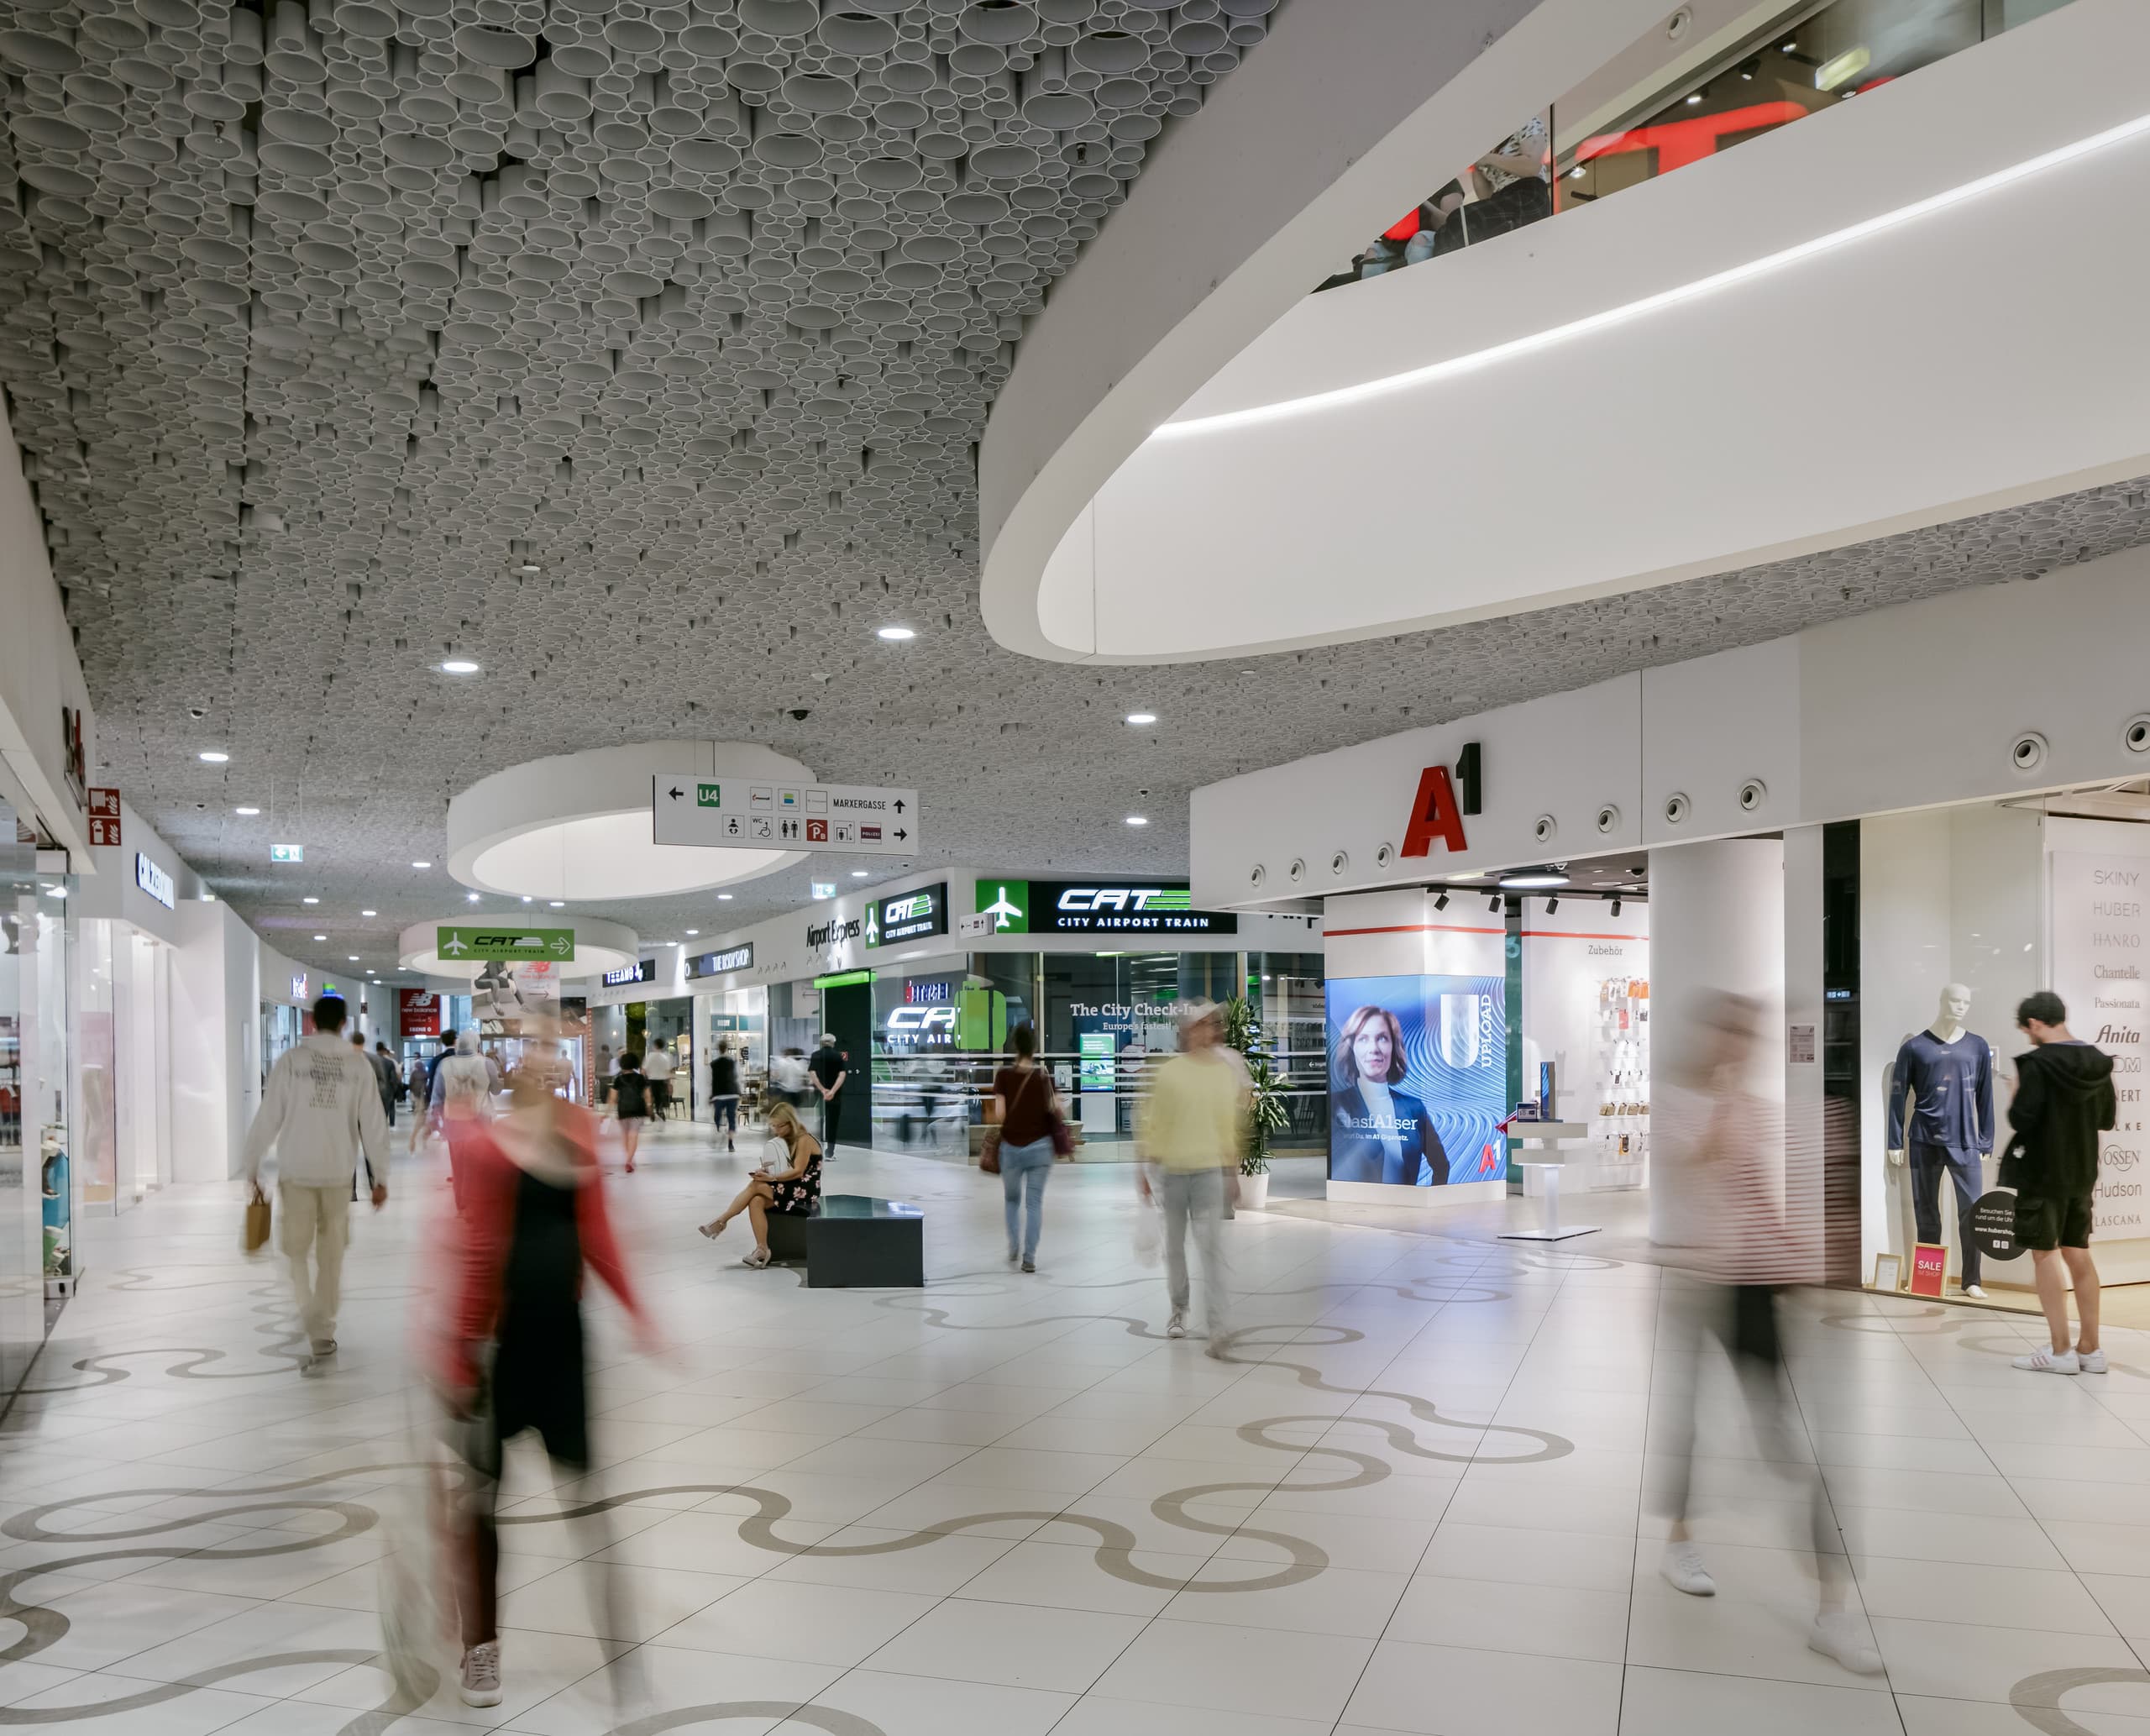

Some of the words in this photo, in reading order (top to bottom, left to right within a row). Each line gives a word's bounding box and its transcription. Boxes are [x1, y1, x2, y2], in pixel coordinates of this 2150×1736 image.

[699, 789, 718, 801] U4
[1400, 742, 1481, 858] A1
[833, 799, 886, 810] MARXERGASSE
[2094, 870, 2140, 886] SKINY
[1057, 889, 1162, 910] CAT
[885, 897, 918, 923] CAT
[2093, 900, 2141, 917] HUBER
[1057, 917, 1090, 927] CITY
[1096, 917, 1159, 927] AIRPORT
[1165, 917, 1209, 927] TRAIN
[474, 936, 522, 946] CAT
[806, 921, 831, 952] Airport
[831, 919, 860, 947] Express
[2093, 933, 2141, 948] HANRO
[1588, 945, 1623, 956] Zubehör
[712, 955, 722, 972] THE
[722, 952, 735, 970] BODY
[735, 948, 749, 968] SHOP
[2094, 964, 2140, 979] Chantelle
[2095, 997, 2140, 1008] Passionata
[887, 1007, 961, 1029] CA
[1070, 1003, 1099, 1016] The
[1101, 1003, 1131, 1020] City
[1103, 1022, 1139, 1032] Europe's
[1481, 994, 1492, 1068] UPLOAD
[2095, 1025, 2141, 1043] Anita
[887, 1034, 920, 1044] CITY
[1478, 1139, 1502, 1173] A1
[2095, 1181, 2142, 1198] Hudson
[1980, 1207, 2004, 1215] Besuchen
[2095, 1214, 2142, 1227] LASCANA
[1917, 1260, 1942, 1272] SALE
